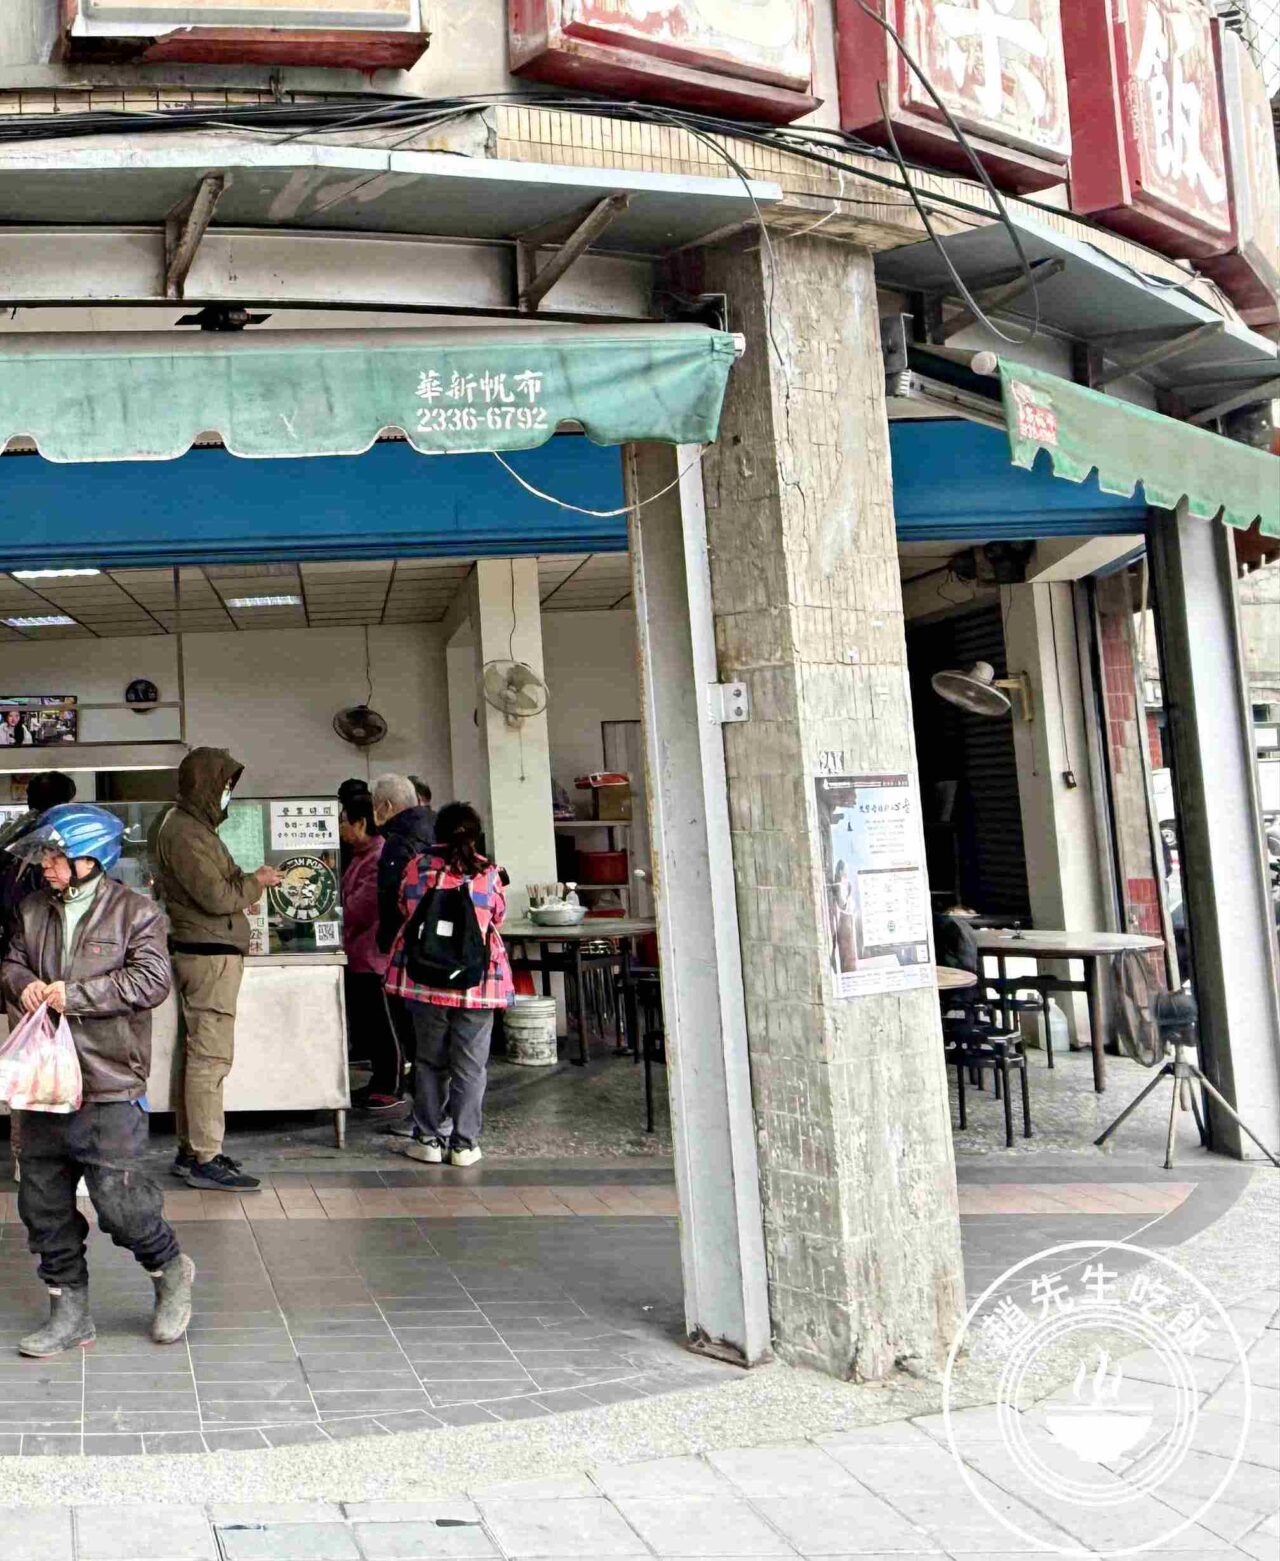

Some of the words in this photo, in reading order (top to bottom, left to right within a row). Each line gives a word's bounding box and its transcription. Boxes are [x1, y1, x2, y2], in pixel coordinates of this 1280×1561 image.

[415, 369, 544, 404] 華新帆布
[416, 407, 549, 432] 2336-6792
